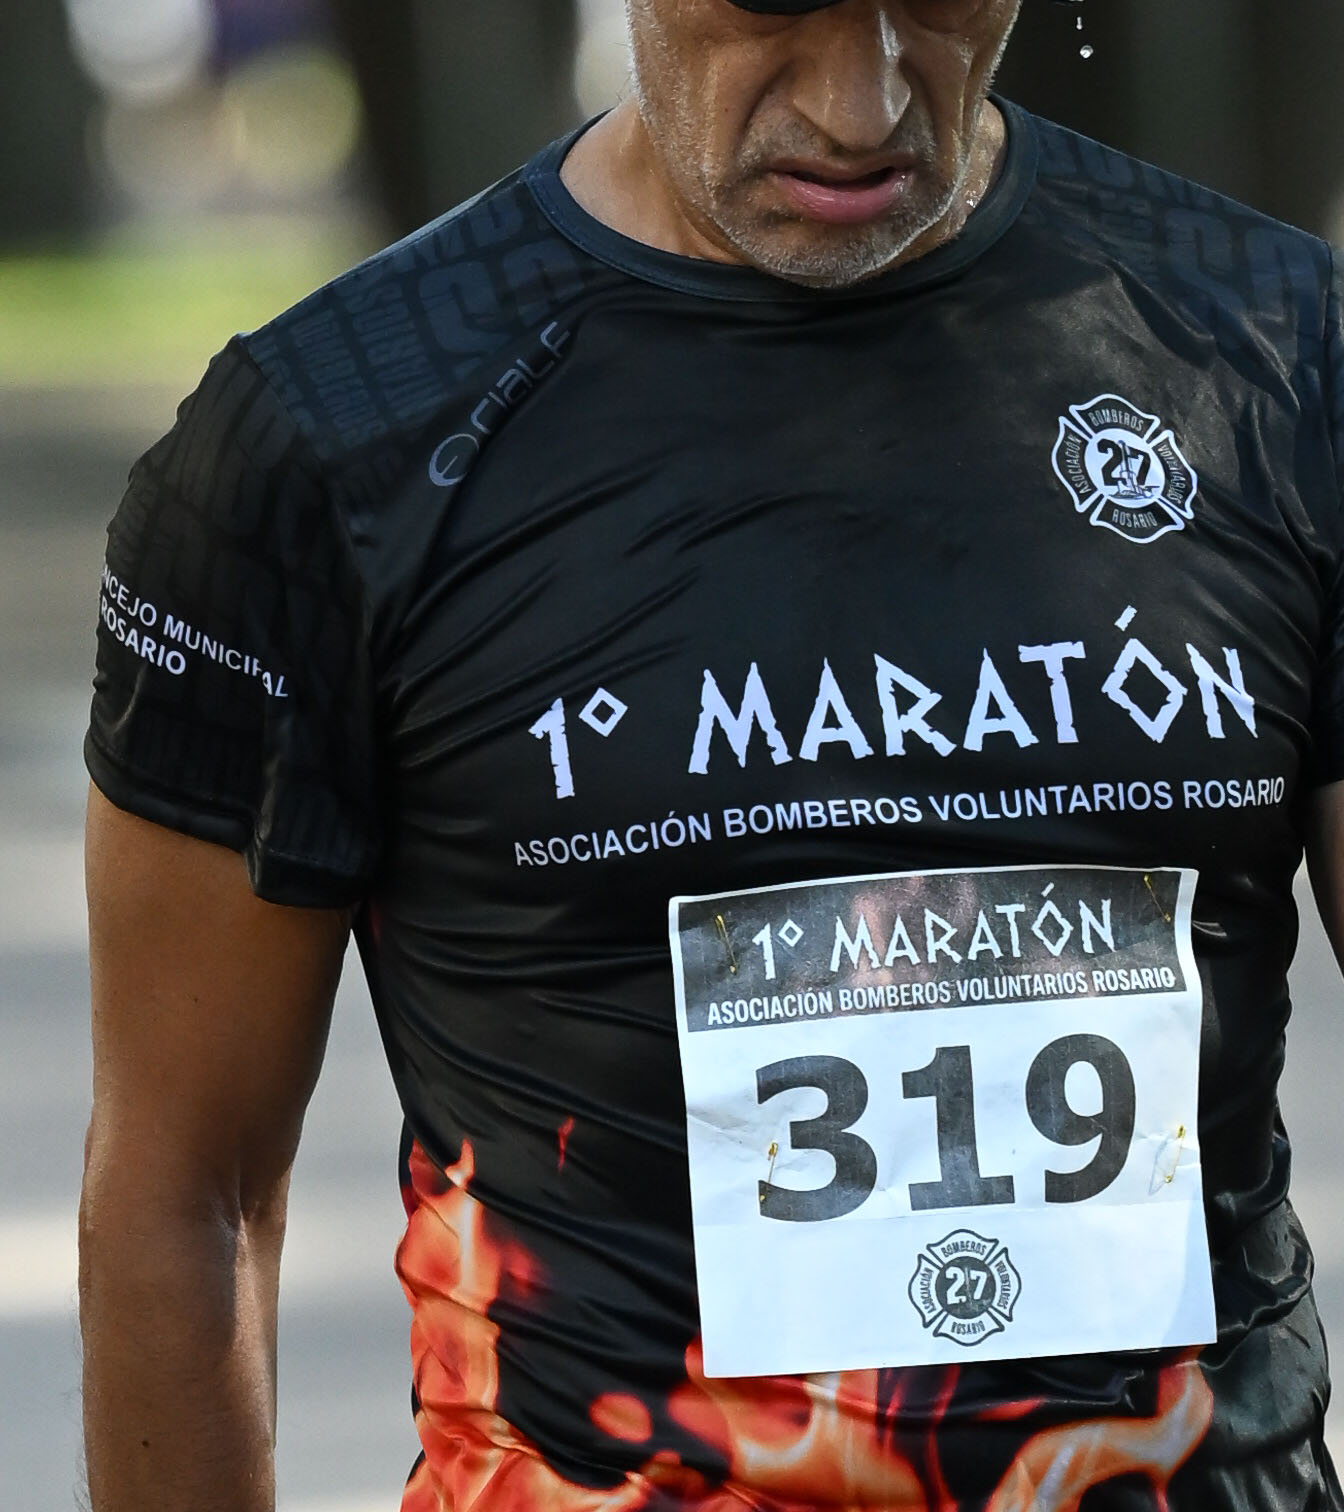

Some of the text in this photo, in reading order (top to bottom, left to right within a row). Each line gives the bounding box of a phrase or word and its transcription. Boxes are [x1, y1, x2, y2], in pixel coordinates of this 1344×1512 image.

[1088, 409, 1145, 431] BOMBEROS
[1097, 438, 1151, 486] 27
[1112, 509, 1158, 528] ROSARIO
[101, 595, 186, 675] ROSARIO
[689, 606, 1257, 774] MARATÓN
[515, 776, 1285, 866] ASOCIACIÓN BOMBEROS VOLUNTARIOS ROSARIO
[830, 883, 1118, 974] MARATÓN
[708, 967, 1177, 1026] ASOCIACIÓN BOMBEROS VOLUNTARIOS ROSARIO
[756, 1034, 1136, 1222] 319
[941, 1240, 987, 1258] BOMBEROS
[945, 1266, 987, 1305] 27
